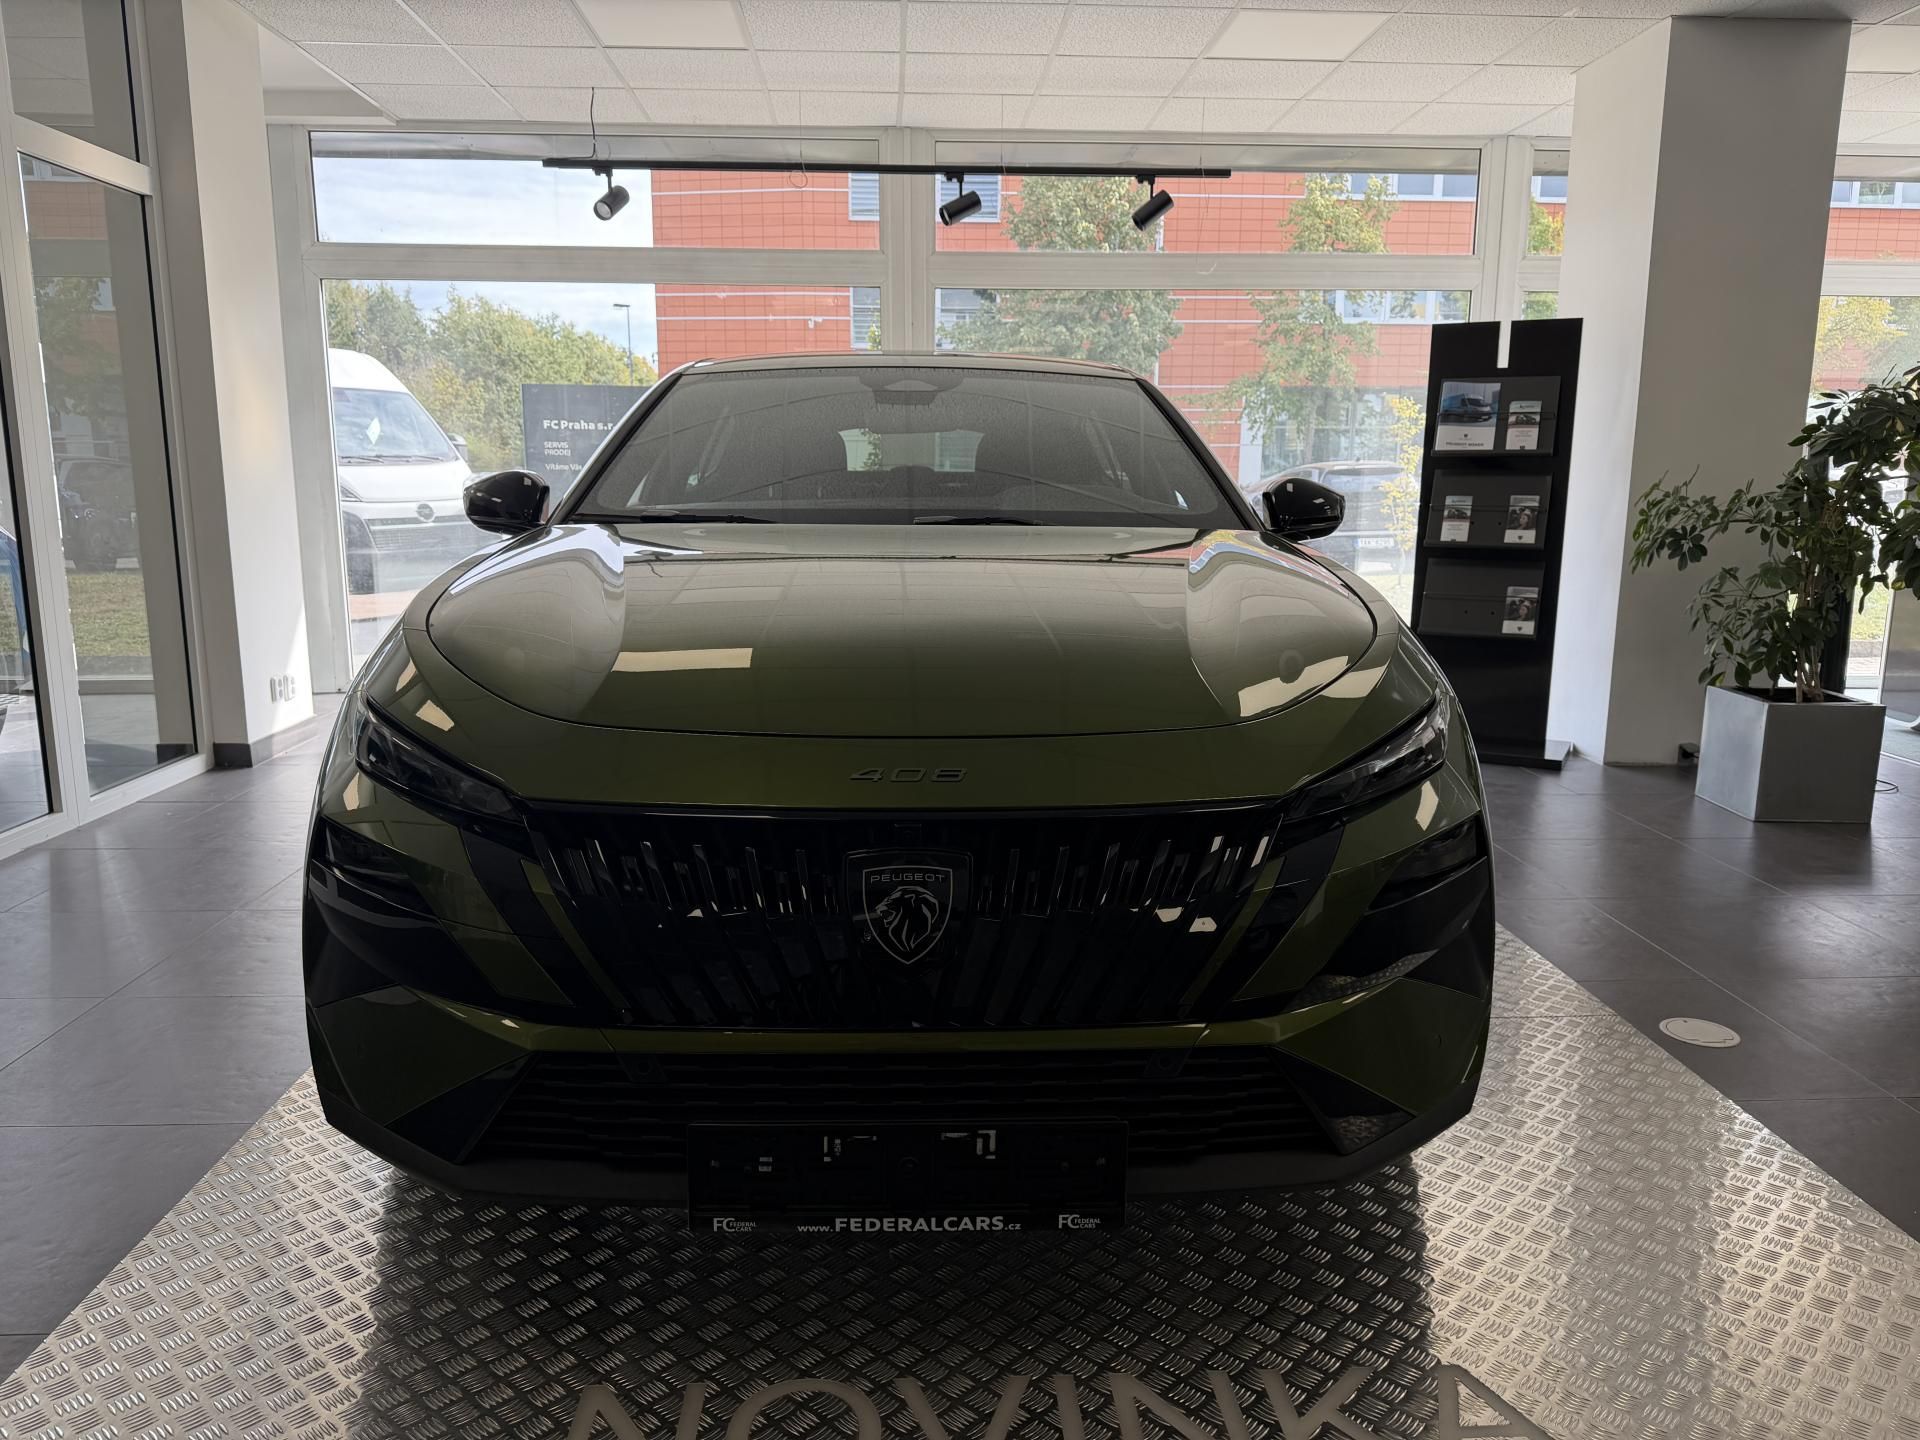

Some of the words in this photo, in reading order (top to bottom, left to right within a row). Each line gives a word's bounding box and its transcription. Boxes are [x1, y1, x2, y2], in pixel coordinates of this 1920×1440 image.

[543, 420, 559, 430] FC
[561, 420, 595, 430] Praha
[849, 767, 968, 783] 408
[870, 873, 945, 884] PEUGEOT
[713, 1217, 735, 1232] FC
[797, 1216, 1022, 1232] www.FEDERALCARS.cz
[1058, 1214, 1080, 1229] FC
